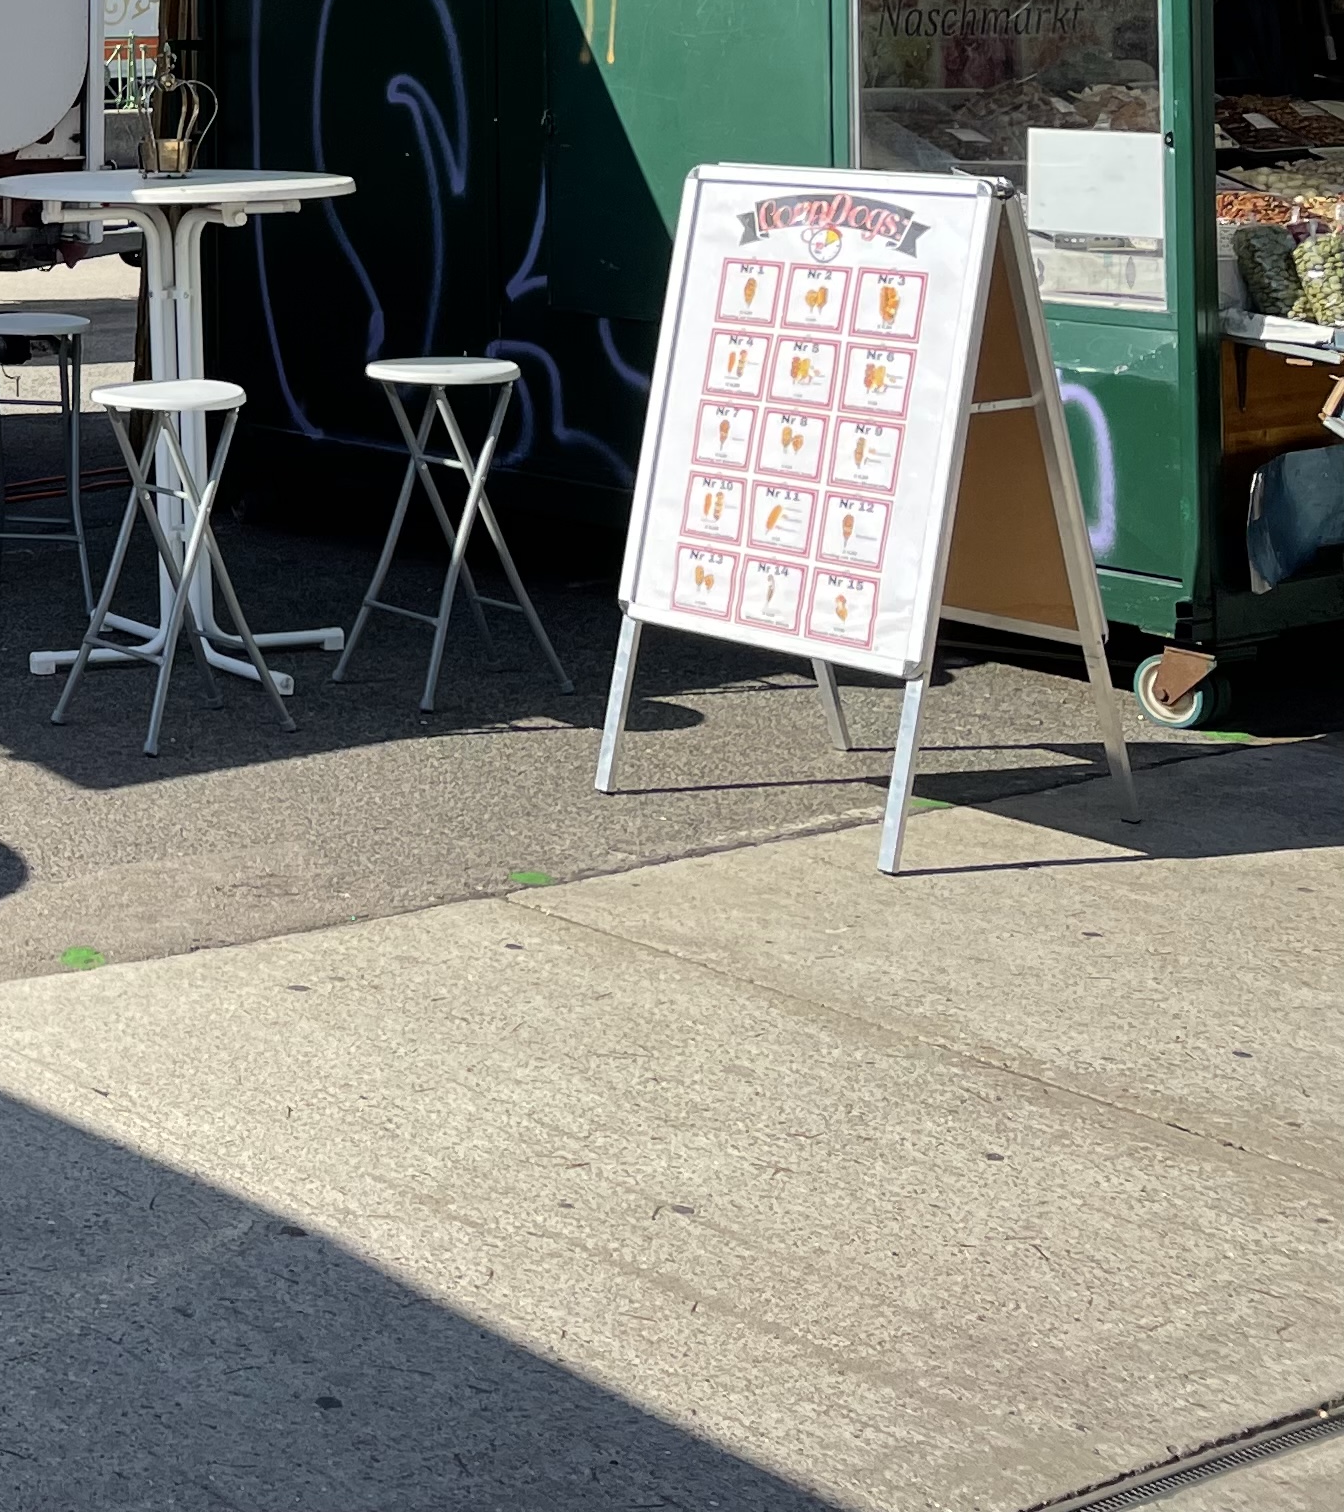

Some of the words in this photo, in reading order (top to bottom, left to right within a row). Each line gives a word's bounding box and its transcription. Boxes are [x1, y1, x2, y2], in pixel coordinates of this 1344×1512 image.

[740, 264, 756, 274] Nr
[807, 269, 823, 279] Nr
[878, 275, 895, 285] Nr
[729, 335, 744, 346] Nr
[793, 342, 809, 352] Nr
[866, 350, 883, 361] Nr
[716, 406, 730, 416] Nr
[781, 414, 797, 425] Nr
[855, 424, 871, 434] Nr
[703, 477, 717, 488] Nr
[766, 487, 781, 497] Nr
[839, 499, 854, 509] Nr
[689, 549, 704, 560] Nr
[758, 563, 772, 573] Nr
[828, 576, 843, 587] Nr
